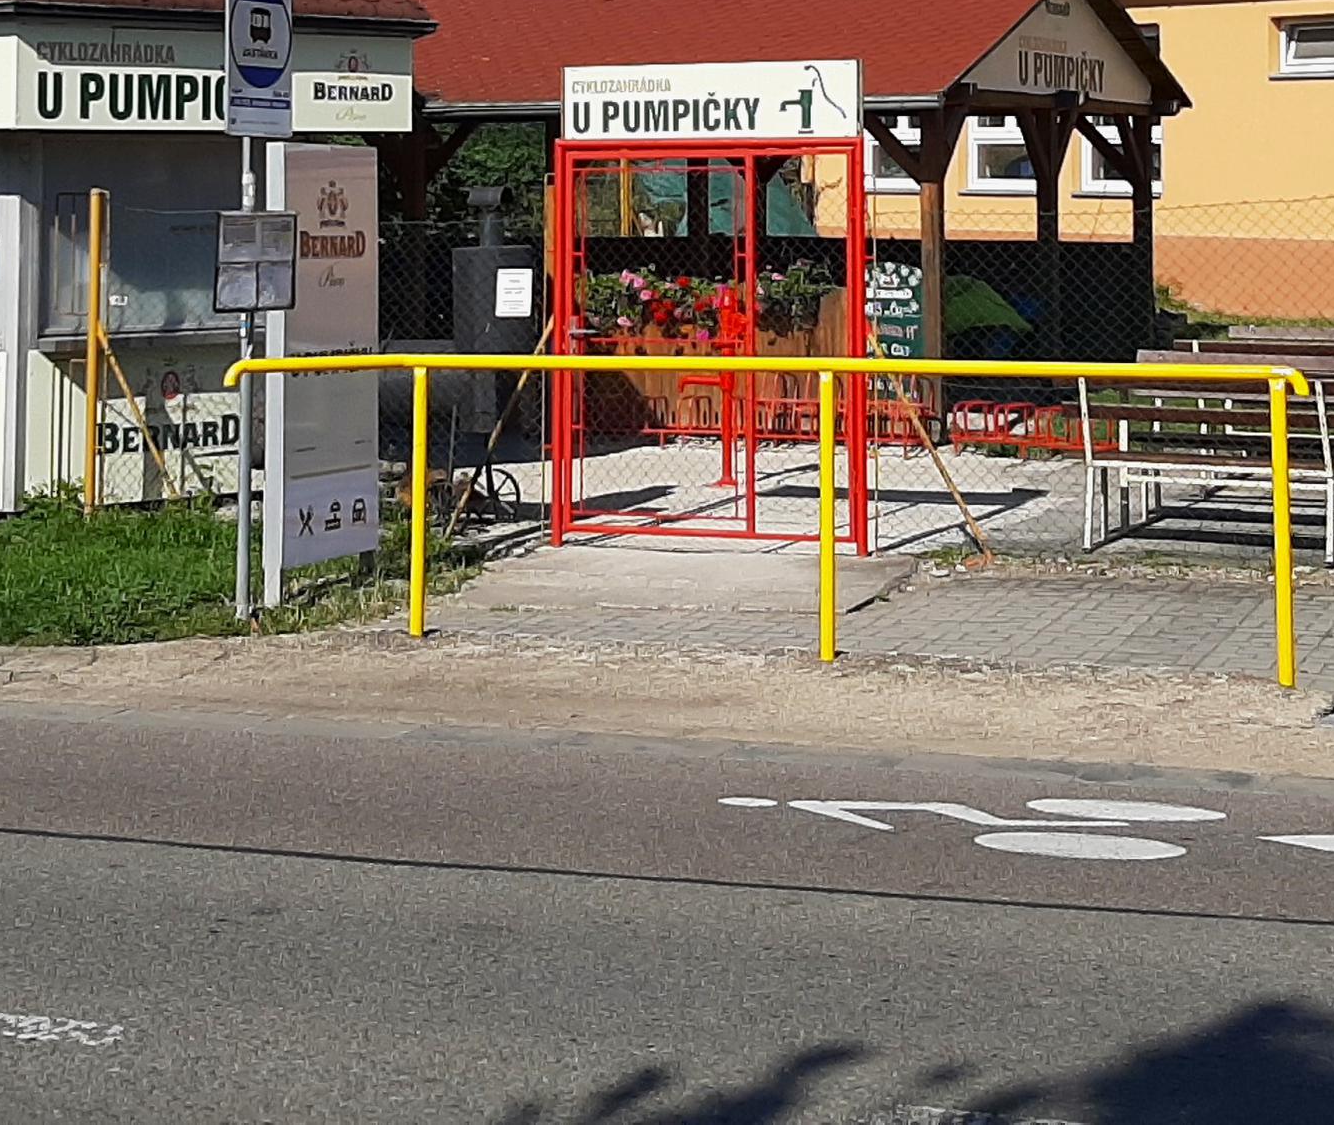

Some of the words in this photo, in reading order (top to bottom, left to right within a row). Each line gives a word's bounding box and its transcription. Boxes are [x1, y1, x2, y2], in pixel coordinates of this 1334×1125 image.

[36, 39, 175, 64] CYKLOZAHRÁDKA
[1018, 50, 1028, 87] U
[1033, 51, 1105, 94] PUMPIČKY
[38, 71, 63, 119] U
[313, 81, 393, 101] BERNARD
[572, 101, 591, 134] U
[602, 92, 760, 134] PUMPIČKY
[299, 230, 366, 259] BERNARD
[97, 413, 241, 454] BERNARD
